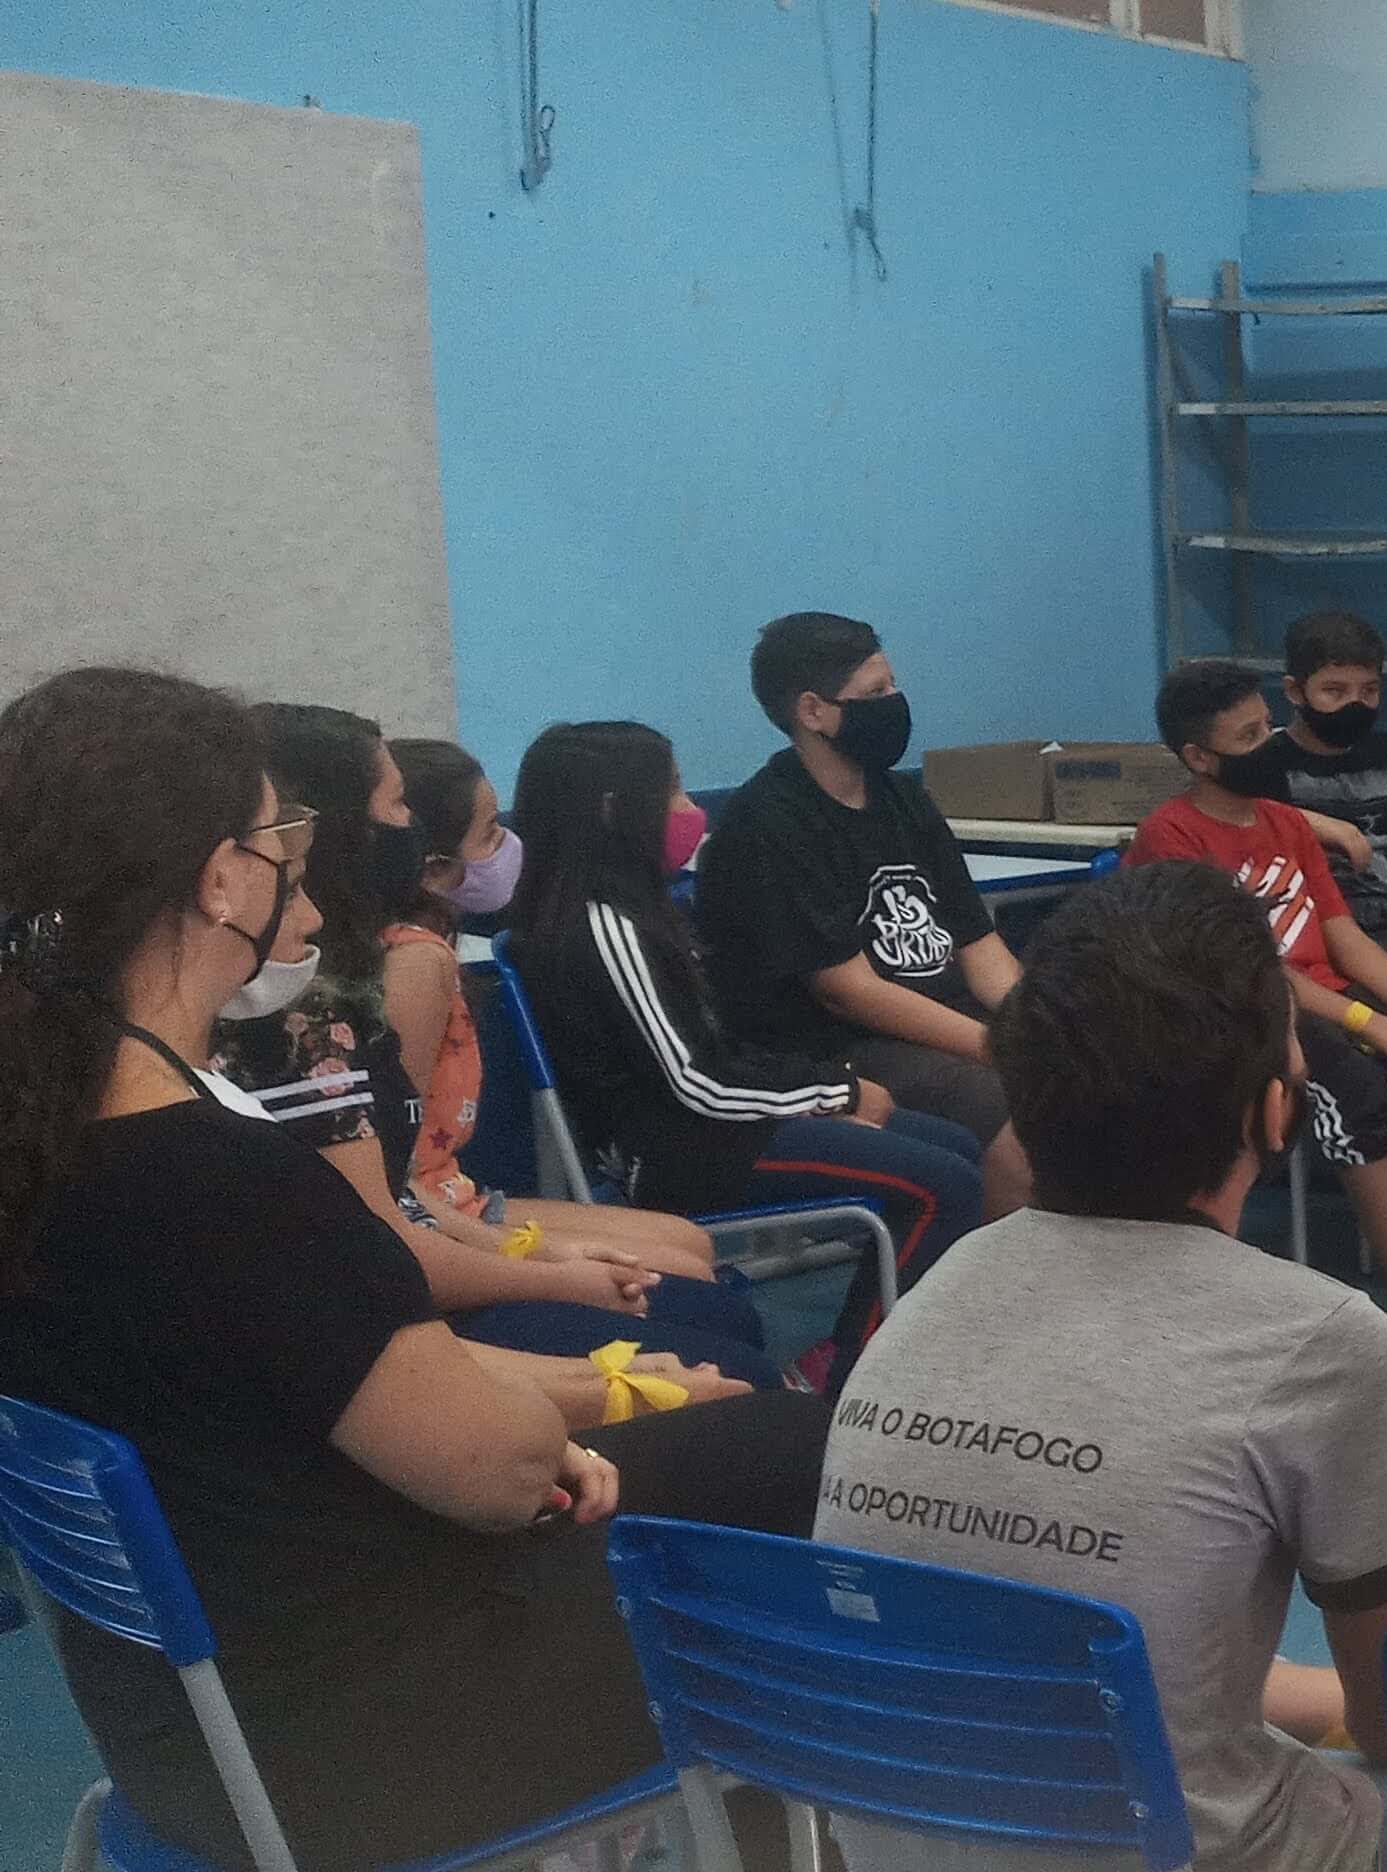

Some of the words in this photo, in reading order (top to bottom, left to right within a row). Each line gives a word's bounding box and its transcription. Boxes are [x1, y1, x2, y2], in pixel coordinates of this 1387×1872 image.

[881, 1408, 904, 1435] O
[904, 1412, 1104, 1474] BOTAFOGO
[848, 1482, 1125, 1563] OPORTUNIDADE
